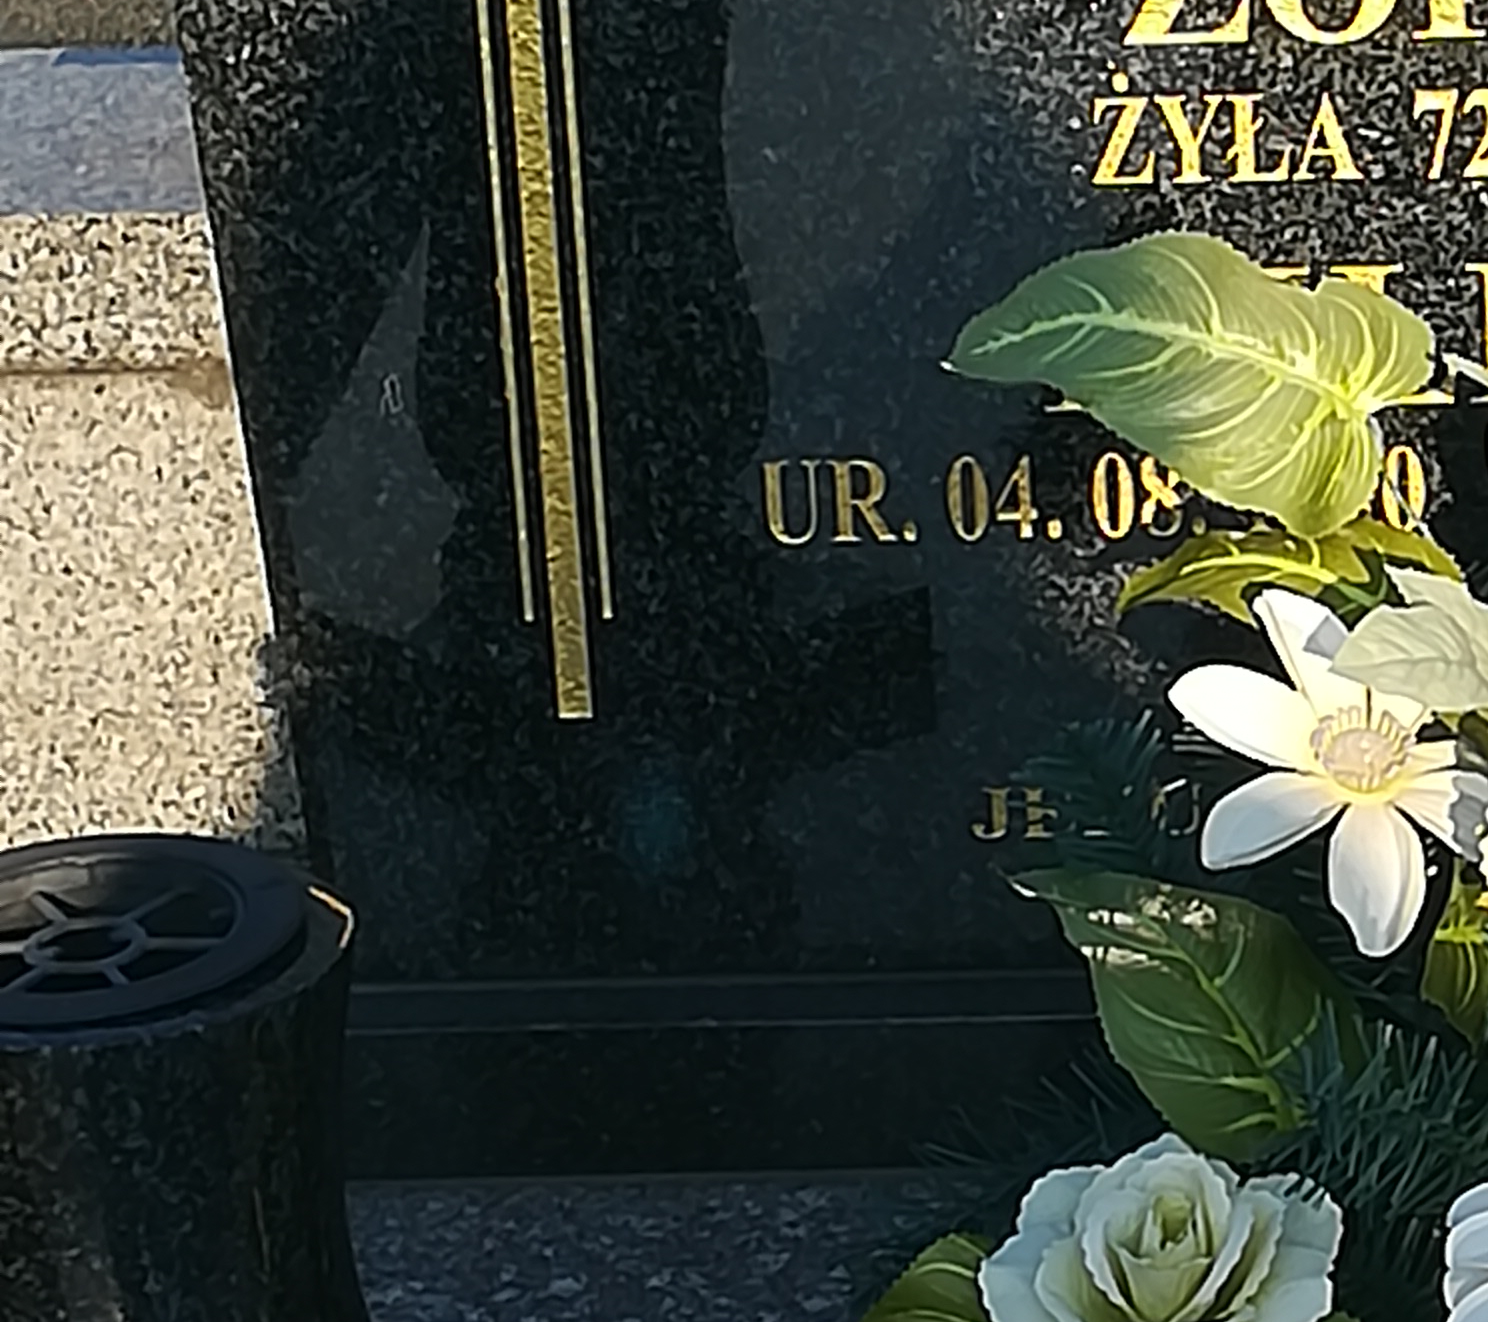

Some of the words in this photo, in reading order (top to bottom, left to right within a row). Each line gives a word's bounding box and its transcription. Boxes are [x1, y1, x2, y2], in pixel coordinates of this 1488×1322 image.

[1091, 70, 1366, 185] ŻYŁA
[761, 455, 919, 546] UR.
[944, 453, 1064, 545] 04.
